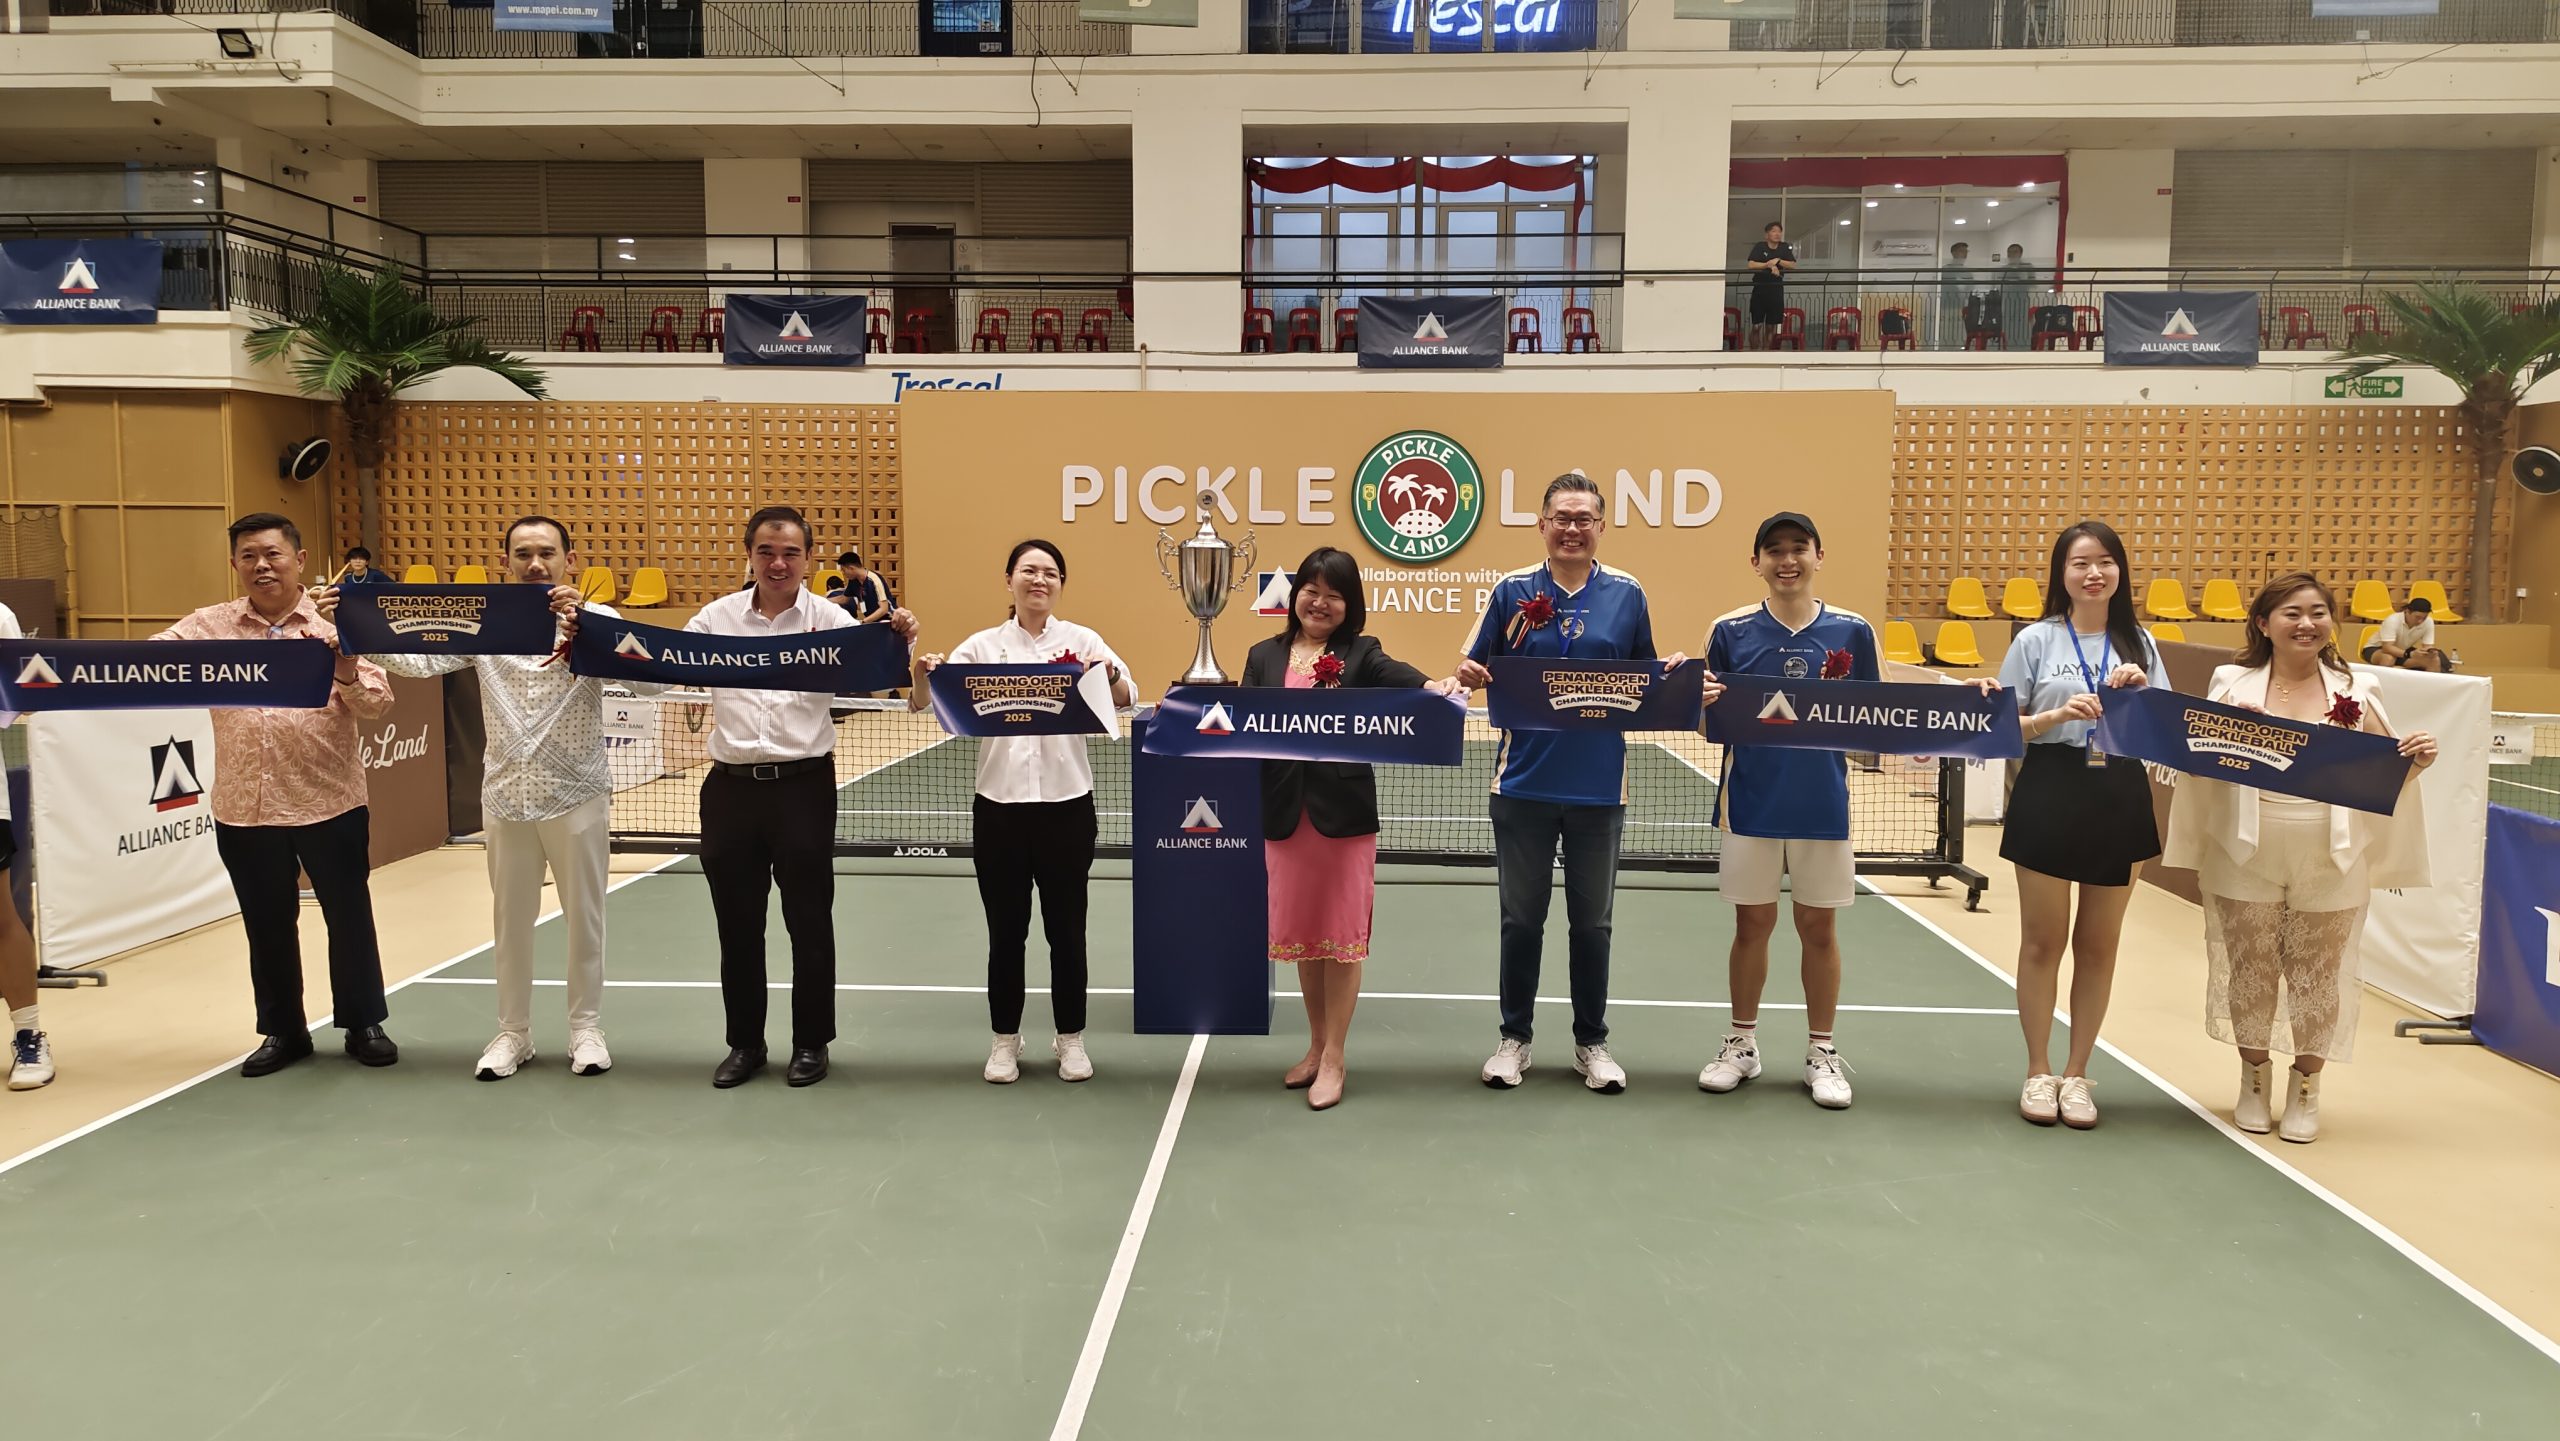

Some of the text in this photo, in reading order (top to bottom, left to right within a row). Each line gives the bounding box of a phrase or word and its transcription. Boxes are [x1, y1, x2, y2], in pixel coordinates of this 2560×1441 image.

[507, 5, 599, 17] www.mapei.com.my
[34, 298, 121, 310] ALLIANCE BANK
[758, 344, 832, 353] ALLIANCE BANK
[1392, 346, 1469, 355] ALLIANCE BANK
[2140, 343, 2221, 352] ALLIANCE BANK
[2362, 379, 2384, 387] FIRE
[1381, 440, 1454, 466] PICKLE
[1062, 465, 1723, 527] PICKLE LND
[1389, 534, 1449, 555] LAND
[1358, 568, 1461, 583] llaboration
[377, 596, 487, 608] PENANG OPEN
[1364, 587, 1462, 613] IANCE
[385, 608, 481, 620] PICKLEBALL
[395, 619, 473, 631] CHAMPIONSHIP
[421, 632, 450, 642] 2025
[661, 646, 842, 667] ALLIANCE BANK
[71, 663, 269, 683] ALLIANCE BANK
[1543, 671, 1650, 686] PENANG OPEN
[965, 674, 1072, 689] PENANG OPEN
[602, 690, 637, 699] JOOLA
[972, 687, 1066, 700] PICKLEBALL
[1549, 683, 1643, 696] PICKLEBALL
[979, 699, 1057, 712] CHAMPIONSHIP
[1555, 696, 1633, 707] CHAMPIONSHIP
[1004, 713, 1032, 723] 2025
[1580, 709, 1607, 718] 2025
[1807, 703, 1993, 733] ALLIANCE BANK
[1243, 713, 1416, 736] ALLIANCE BANK
[2184, 709, 2309, 747] PENANG OPEN
[2188, 721, 2297, 757] PICKLEBALL
[373, 723, 429, 769] Land
[2193, 741, 2282, 764] CHAMPIONSHIP
[2218, 756, 2251, 770] 2025
[117, 813, 216, 857] ALLIANCE BA
[1156, 838, 1248, 849] ALLIANCE BANK
[903, 847, 949, 857] JOOLA
